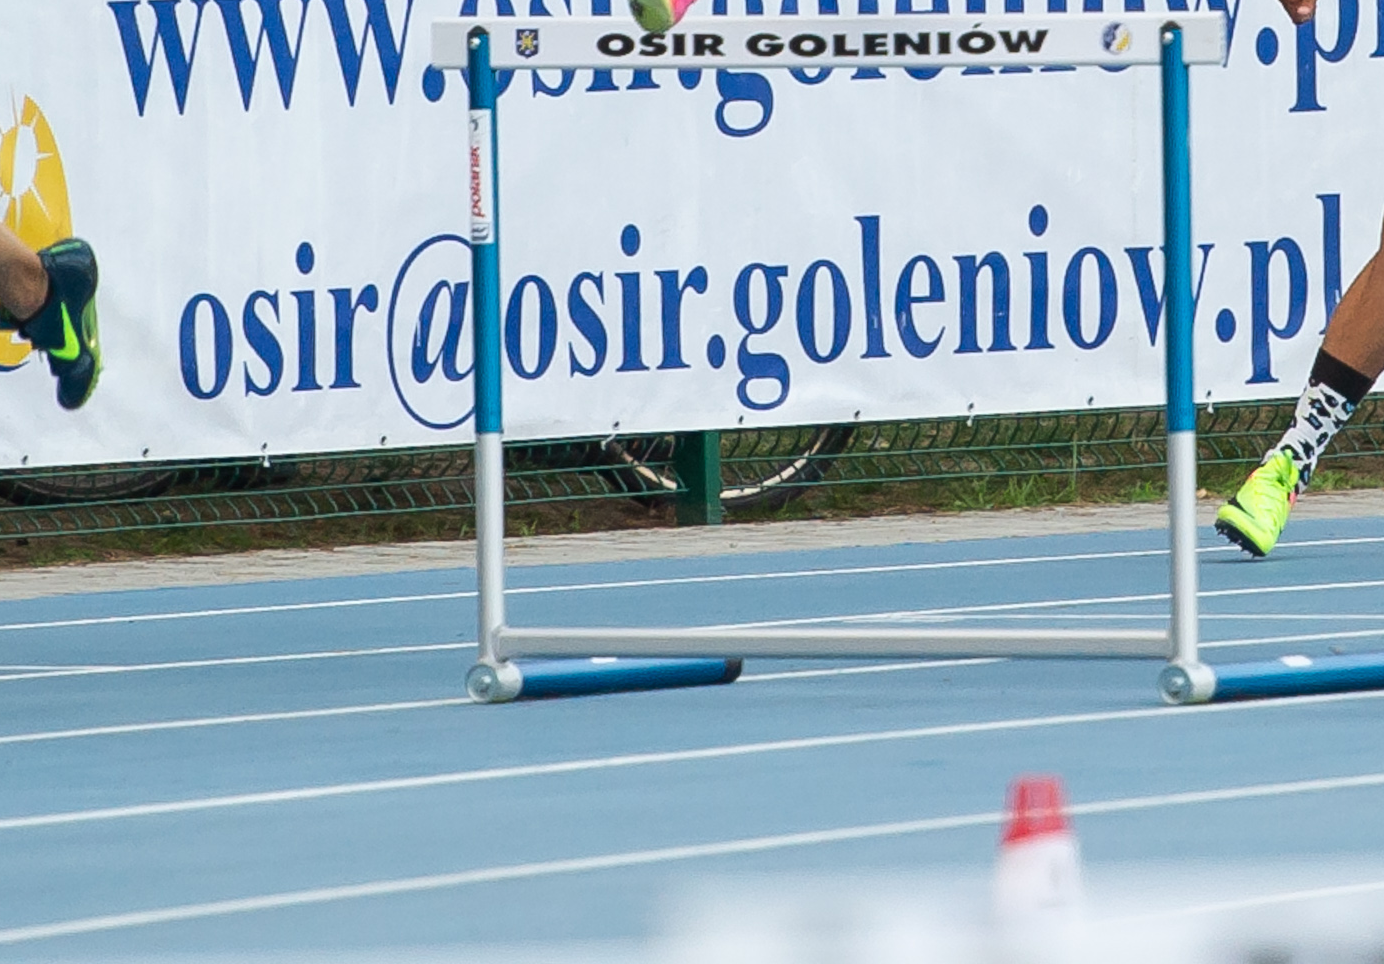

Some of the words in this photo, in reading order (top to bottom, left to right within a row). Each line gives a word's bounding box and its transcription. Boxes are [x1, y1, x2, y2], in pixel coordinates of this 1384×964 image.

[596, 33, 726, 57] OSIR
[745, 23, 1049, 57] GOLENIÓW
[179, 193, 1342, 430] osir@osir.goleniow.pl
